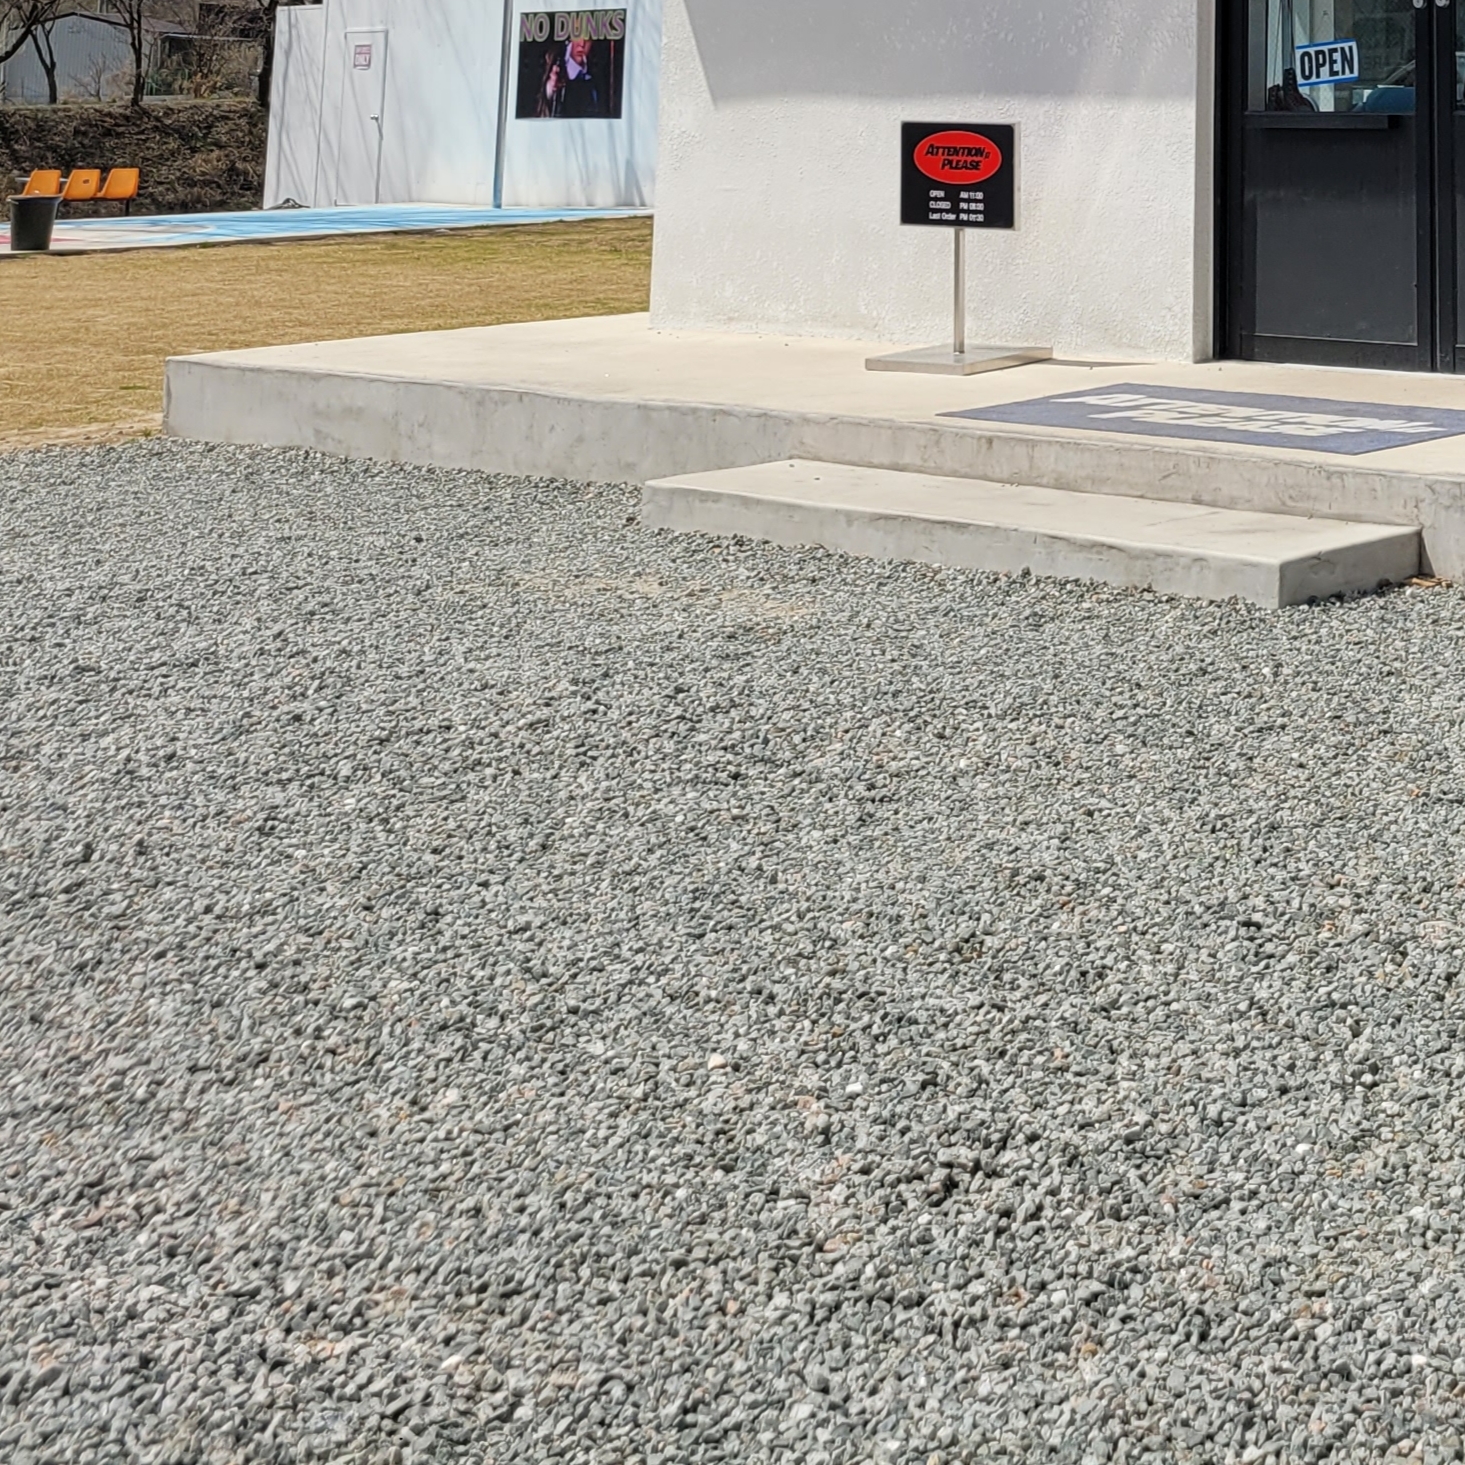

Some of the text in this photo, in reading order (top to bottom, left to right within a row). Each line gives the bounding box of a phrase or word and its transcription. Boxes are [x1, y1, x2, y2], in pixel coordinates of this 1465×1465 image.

[520, 10, 625, 43] NO DUNKS
[1300, 45, 1355, 81] OPEN
[940, 157, 982, 171] PLEASE
